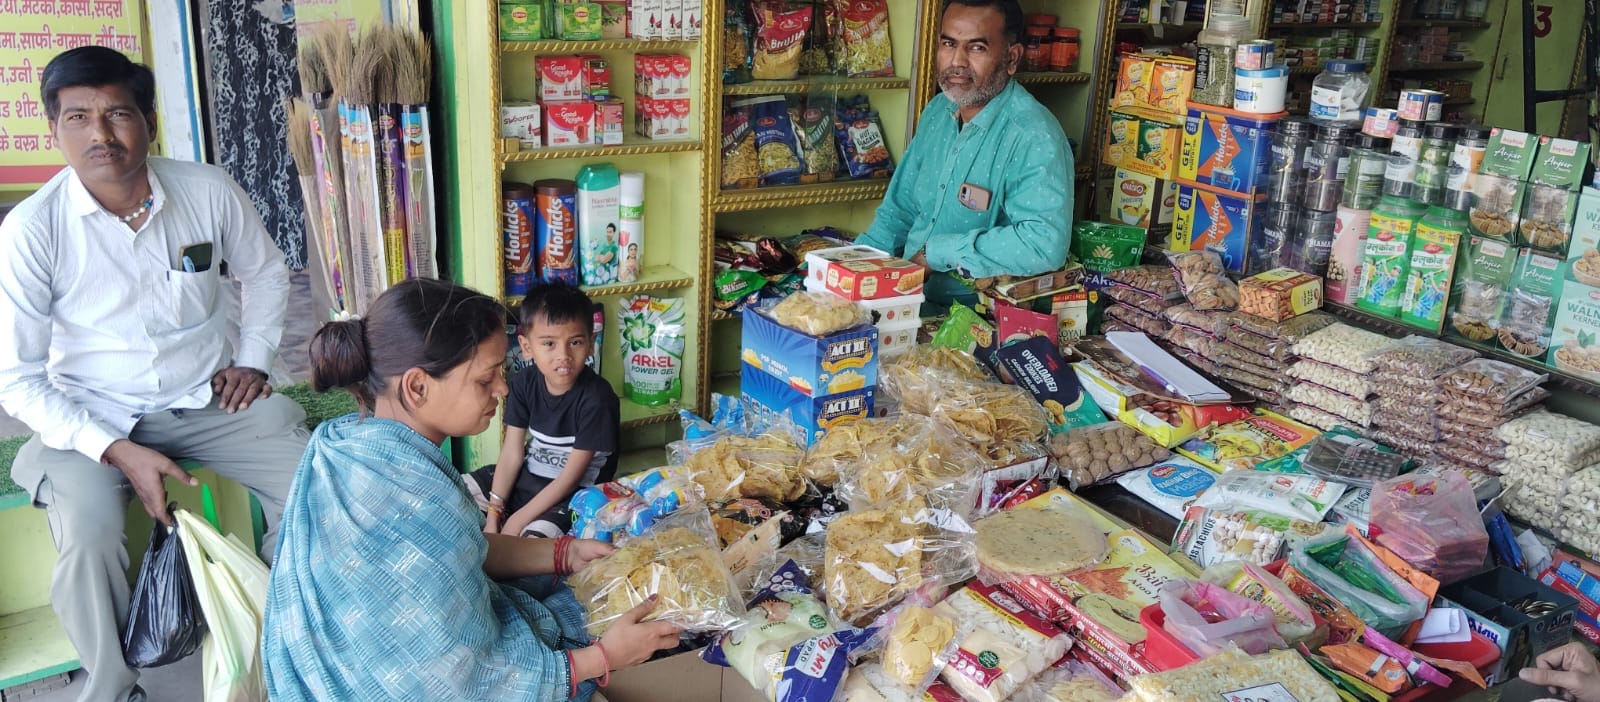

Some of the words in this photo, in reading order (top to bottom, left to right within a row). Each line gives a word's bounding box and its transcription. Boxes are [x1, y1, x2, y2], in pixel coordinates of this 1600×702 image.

[505, 201, 521, 261] Horlicks
[546, 197, 564, 257] Horlicks
[1175, 213, 1184, 240] GET
[1208, 200, 1222, 240] Horlicks
[832, 342, 852, 357] ACT
[631, 366, 659, 375] POWER
[1010, 358, 1026, 380] CASHEW
[1021, 349, 1058, 393] OVERLOADED
[1024, 363, 1044, 385] COOKIES
[827, 401, 847, 415] ACT
